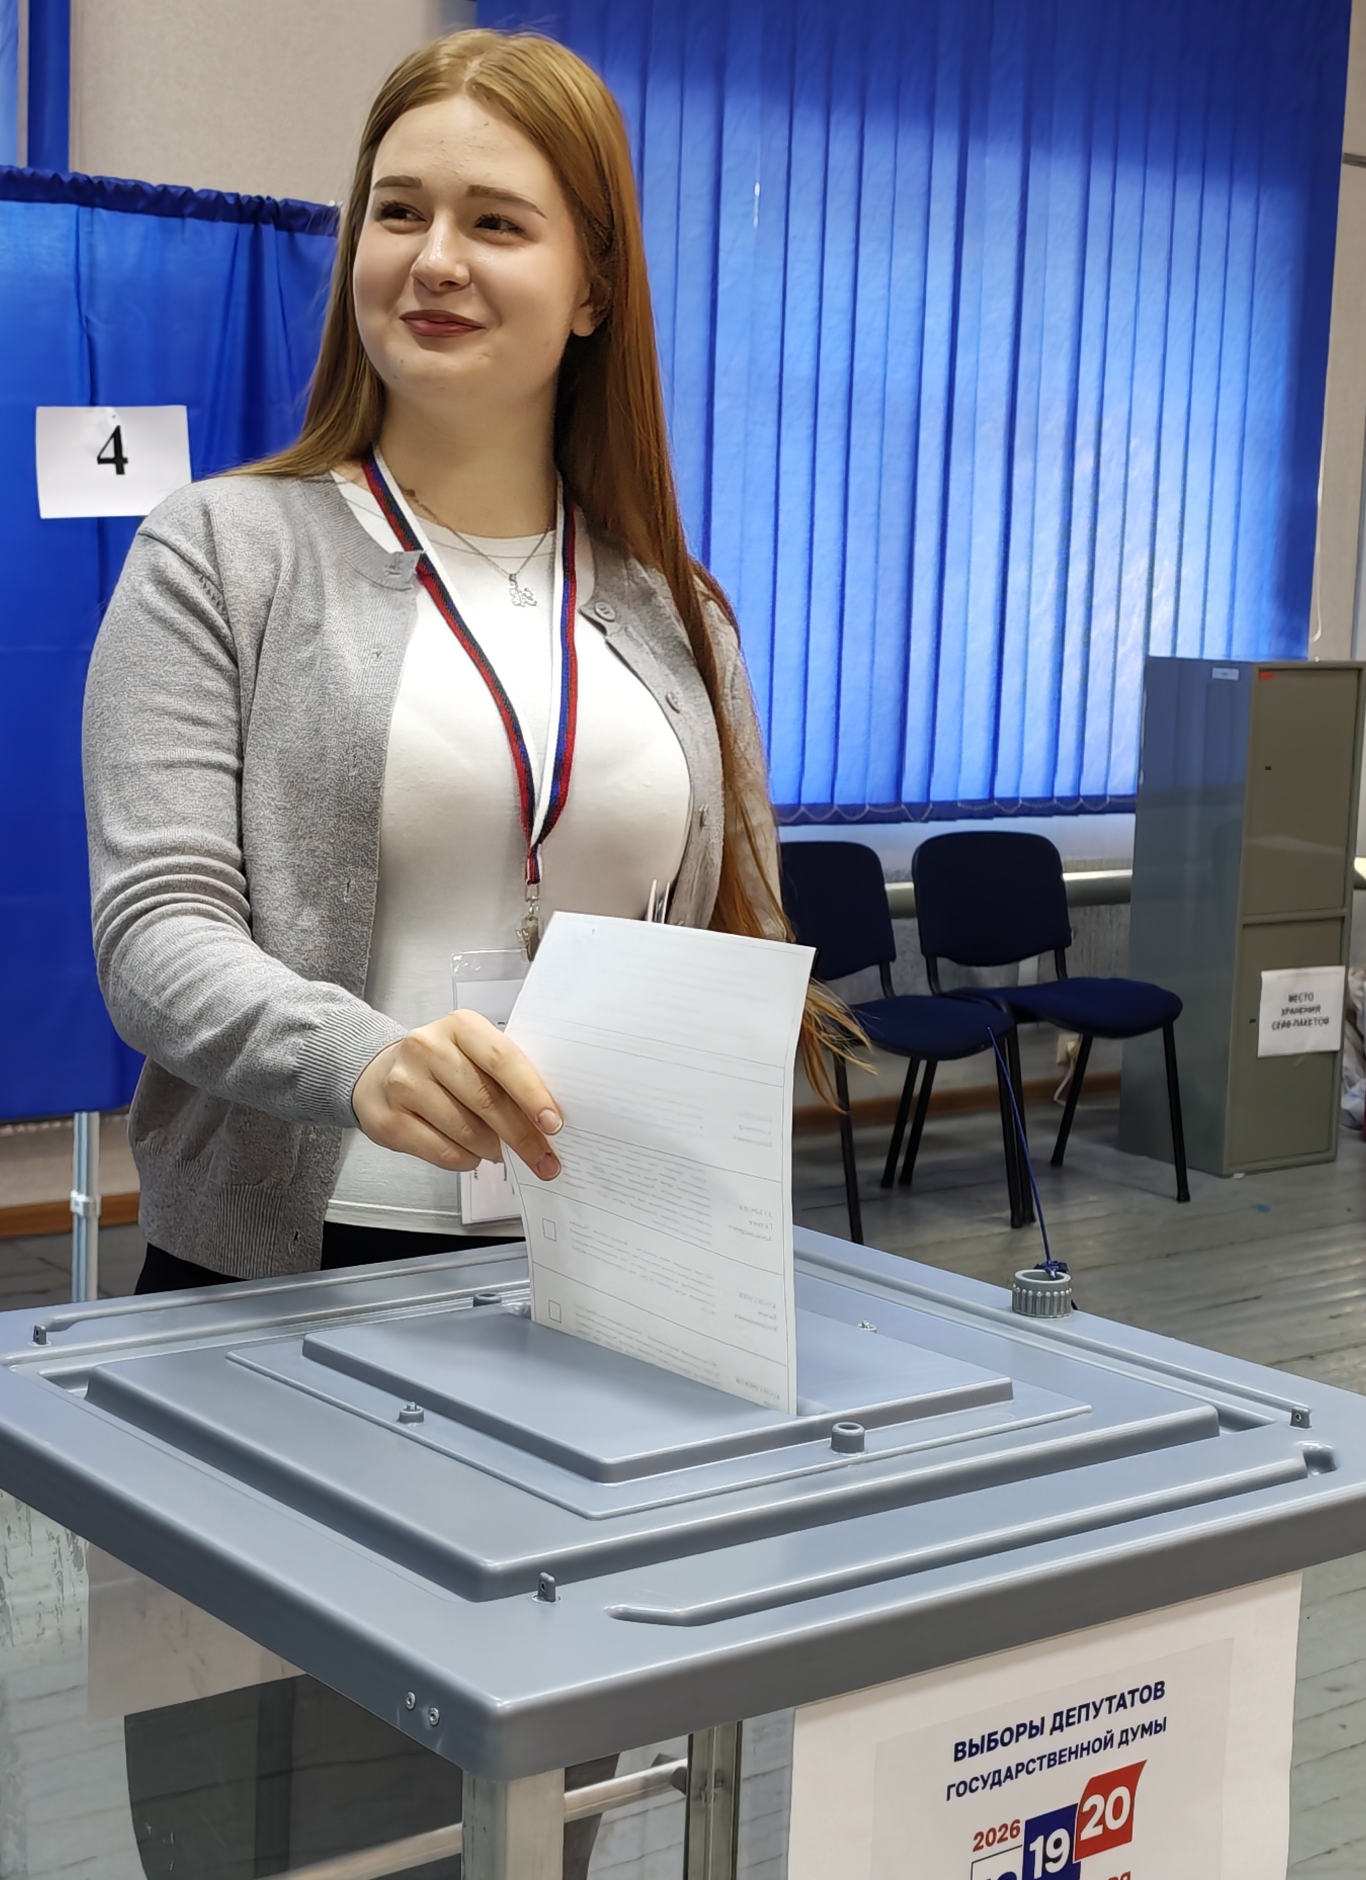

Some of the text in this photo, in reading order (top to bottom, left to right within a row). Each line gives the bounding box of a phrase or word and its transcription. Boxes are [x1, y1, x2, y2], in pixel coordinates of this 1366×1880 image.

[97, 425, 128, 476] 4
[953, 1680, 1166, 1763] ВЫБОРЫ ДЕПУТАТОВ
[946, 1716, 1167, 1801] ГОСУДАРСТВЕННОЙ ДУМЫ
[972, 1818, 1021, 1853] 2026
[1080, 1785, 1132, 1842] 20
[1029, 1827, 1071, 1880] 19
